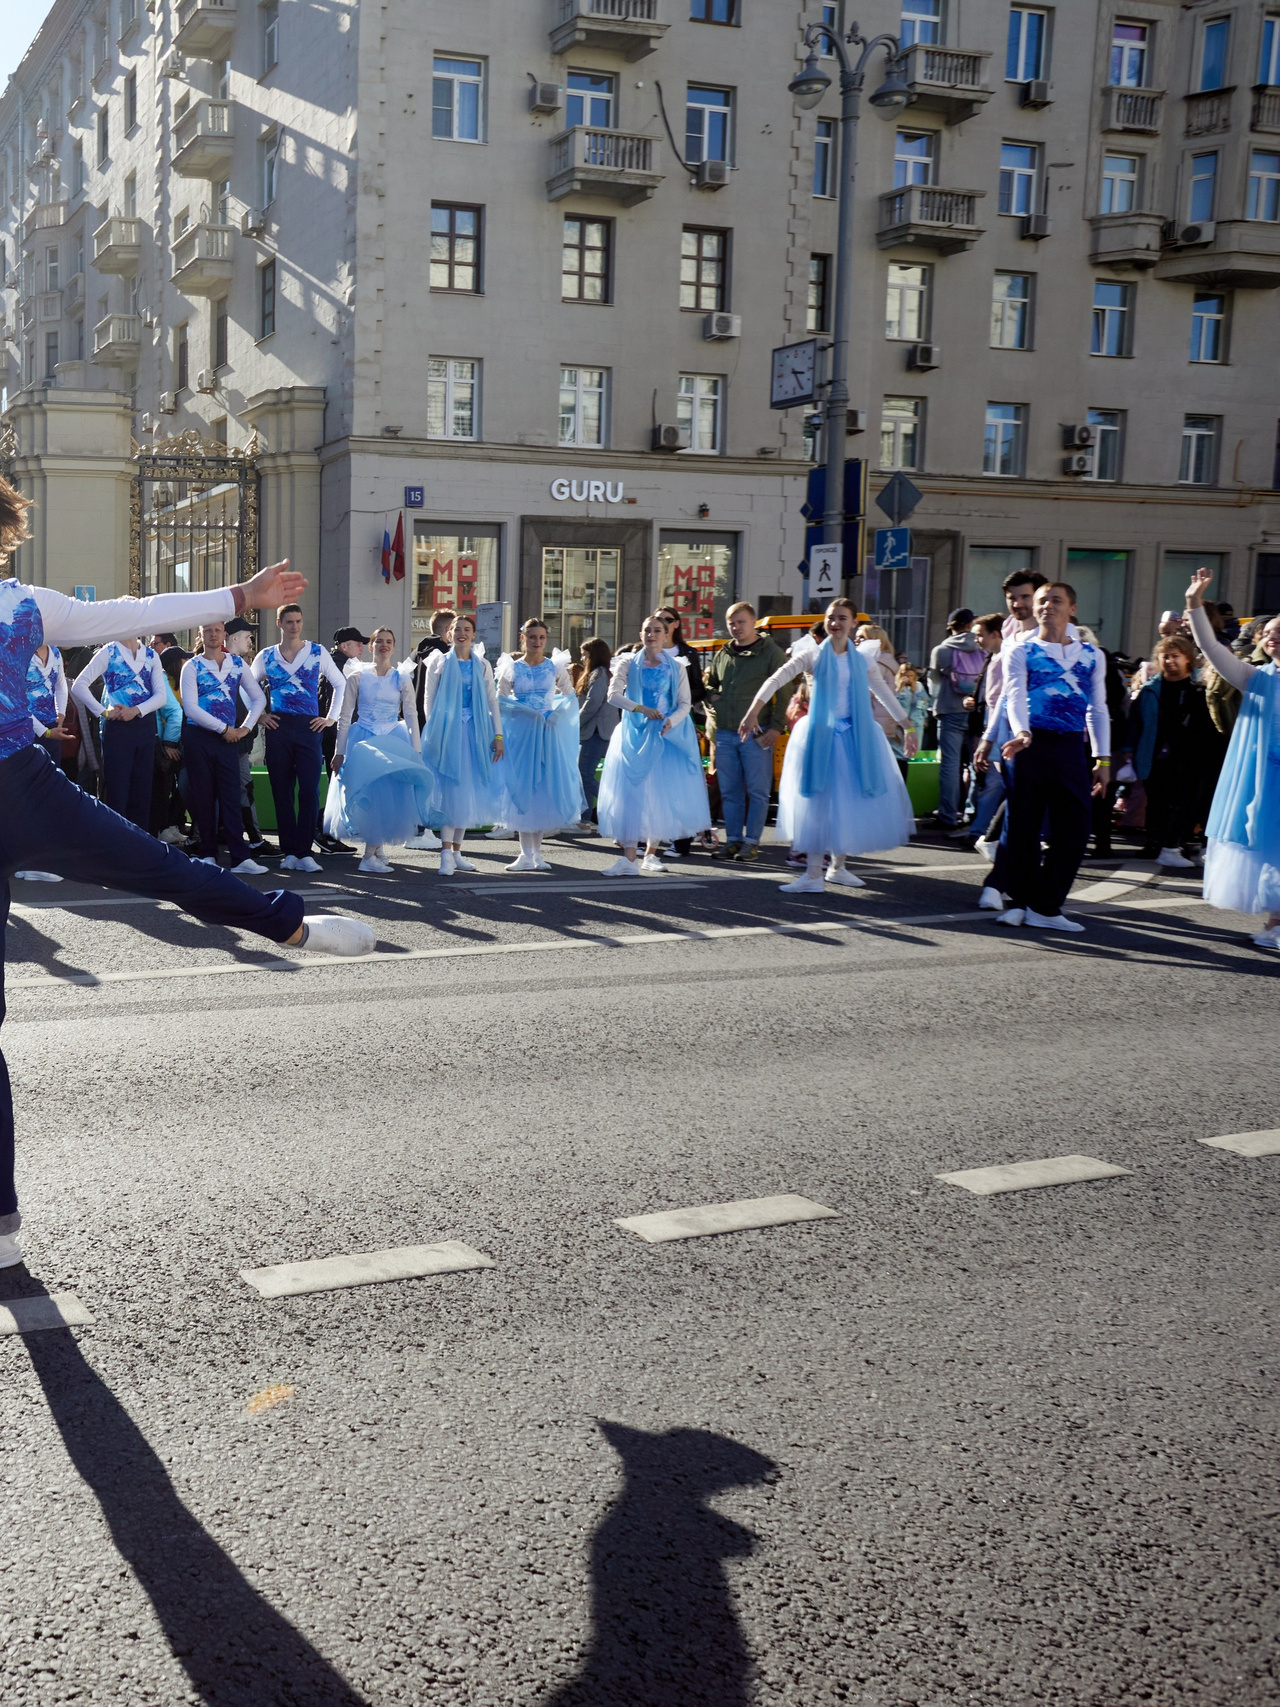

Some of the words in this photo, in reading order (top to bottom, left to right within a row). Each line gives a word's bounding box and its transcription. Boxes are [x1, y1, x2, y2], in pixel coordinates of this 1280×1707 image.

[410, 491, 421, 502] 15
[551, 478, 624, 503] GURU
[433, 559, 478, 582] МО
[674, 565, 715, 587] МО
[432, 586, 477, 609] СК
[673, 591, 715, 613] СК
